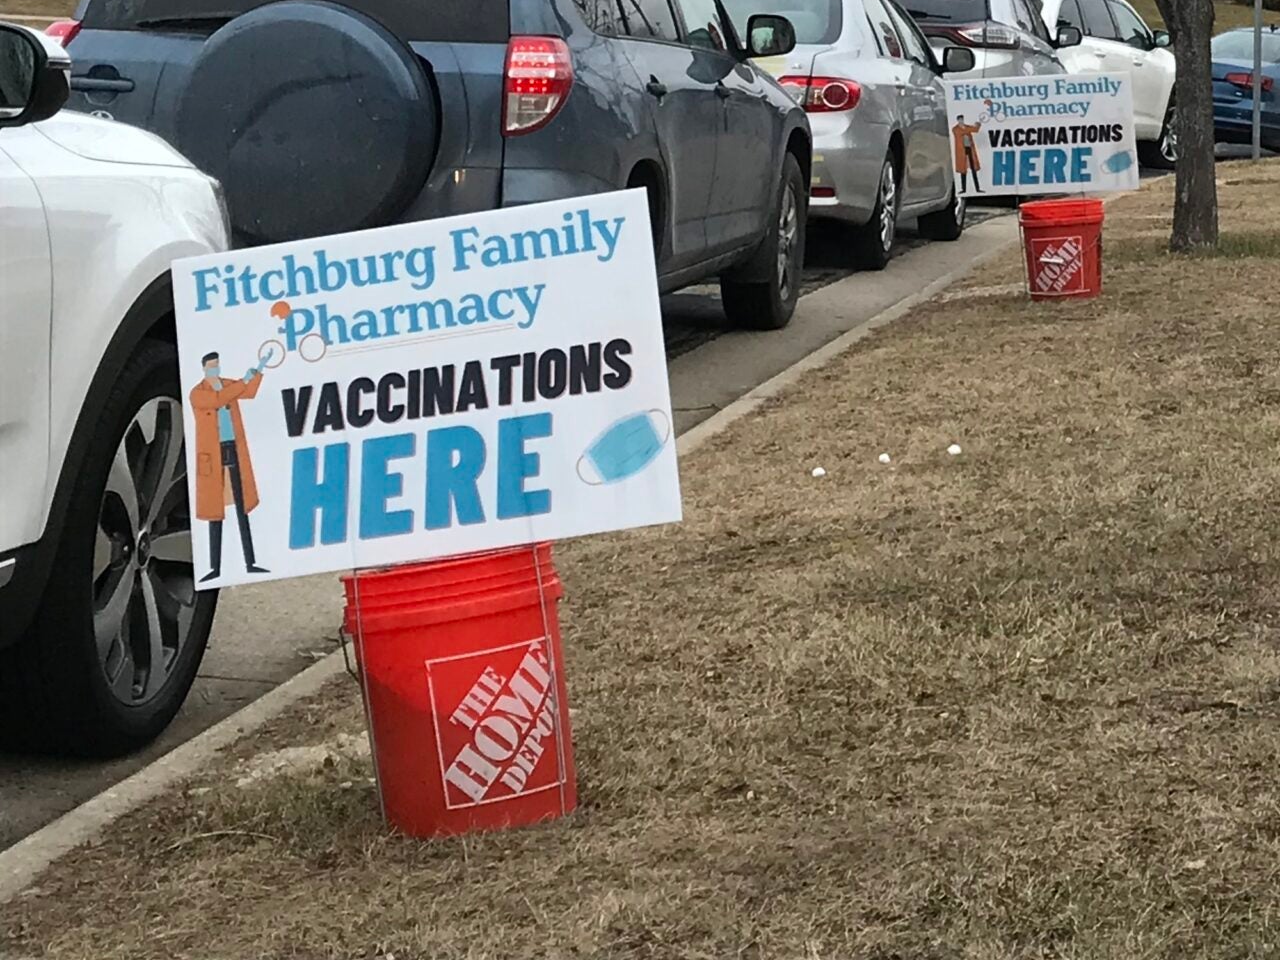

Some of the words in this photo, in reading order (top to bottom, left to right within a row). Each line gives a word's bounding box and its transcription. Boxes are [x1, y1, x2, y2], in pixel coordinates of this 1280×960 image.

[952, 81, 1048, 101] Fitchburg
[1054, 77, 1122, 97] Family
[988, 101, 1090, 118] Pharmacy
[988, 124, 1123, 148] VACCINATIONS
[992, 146, 1092, 186] HERE
[192, 244, 435, 312] Fitchburg
[450, 209, 625, 272] Family
[1035, 237, 1082, 292] HOME
[281, 284, 546, 351] Pharmacy
[281, 338, 633, 437] VACCINATIONS
[288, 412, 553, 550] HERE
[443, 640, 552, 803] HOME
[449, 665, 507, 731] THE
[499, 693, 556, 795] DEPO
